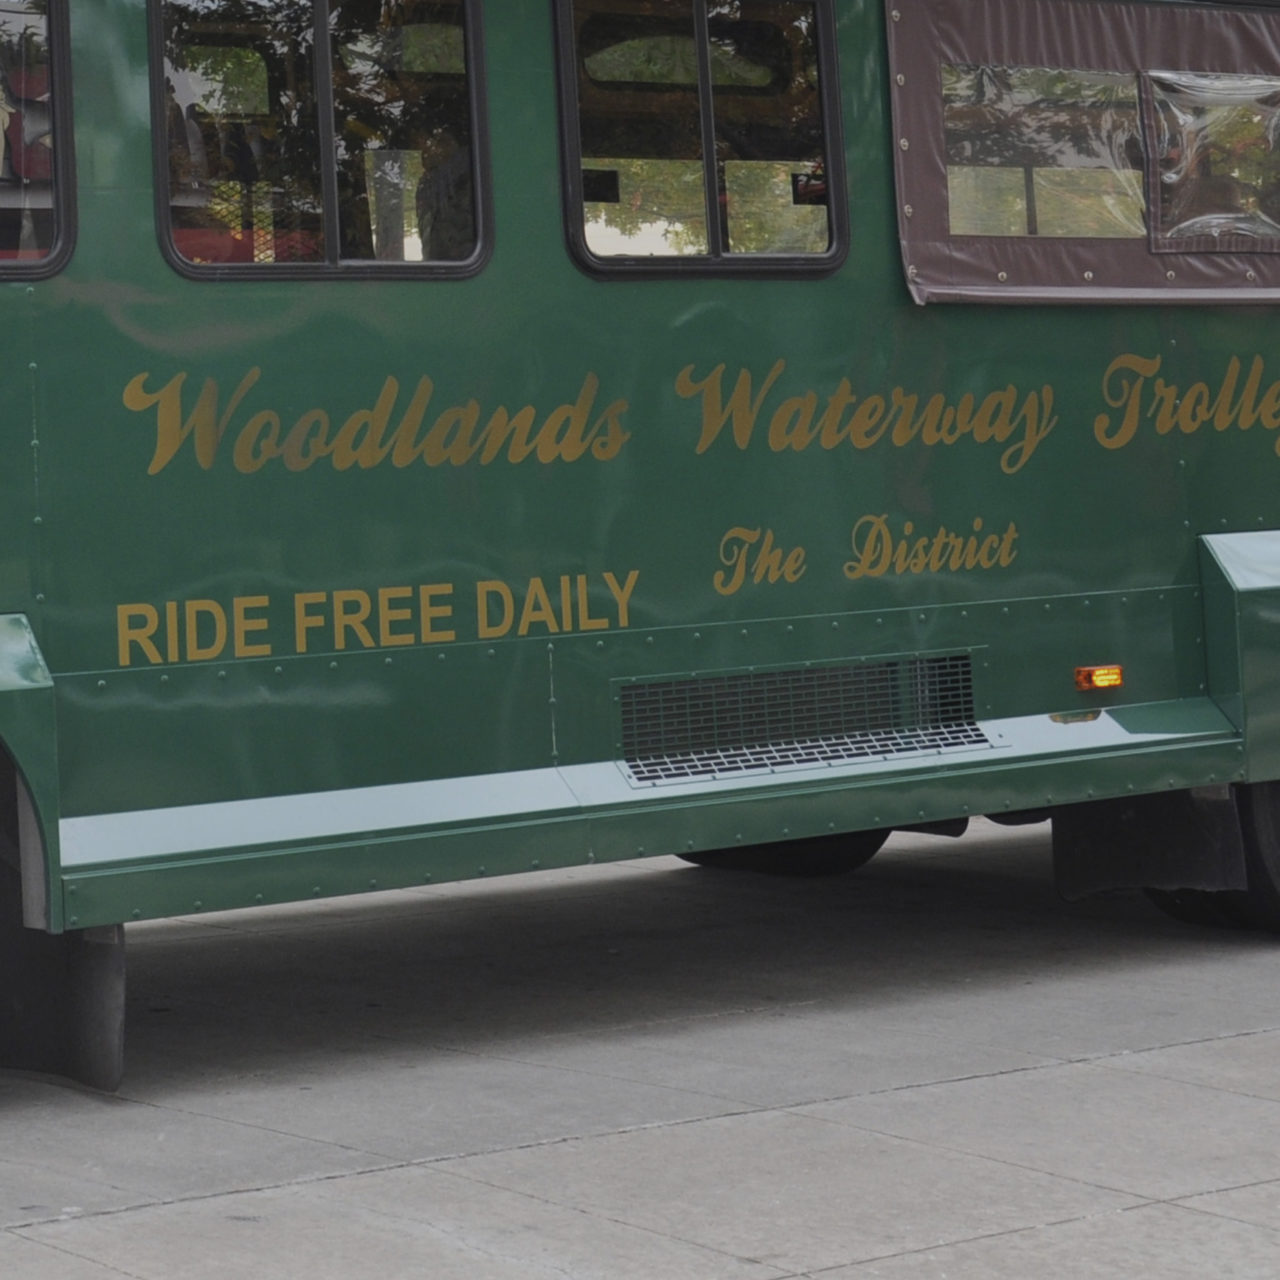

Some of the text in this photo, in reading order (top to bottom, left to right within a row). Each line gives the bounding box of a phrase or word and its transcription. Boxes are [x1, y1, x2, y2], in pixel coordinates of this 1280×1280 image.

[122, 353, 1280, 476] Woodlands Waterway Trolle
[713, 513, 1020, 597] The District
[116, 570, 640, 667] RIDE FREE DAILY
